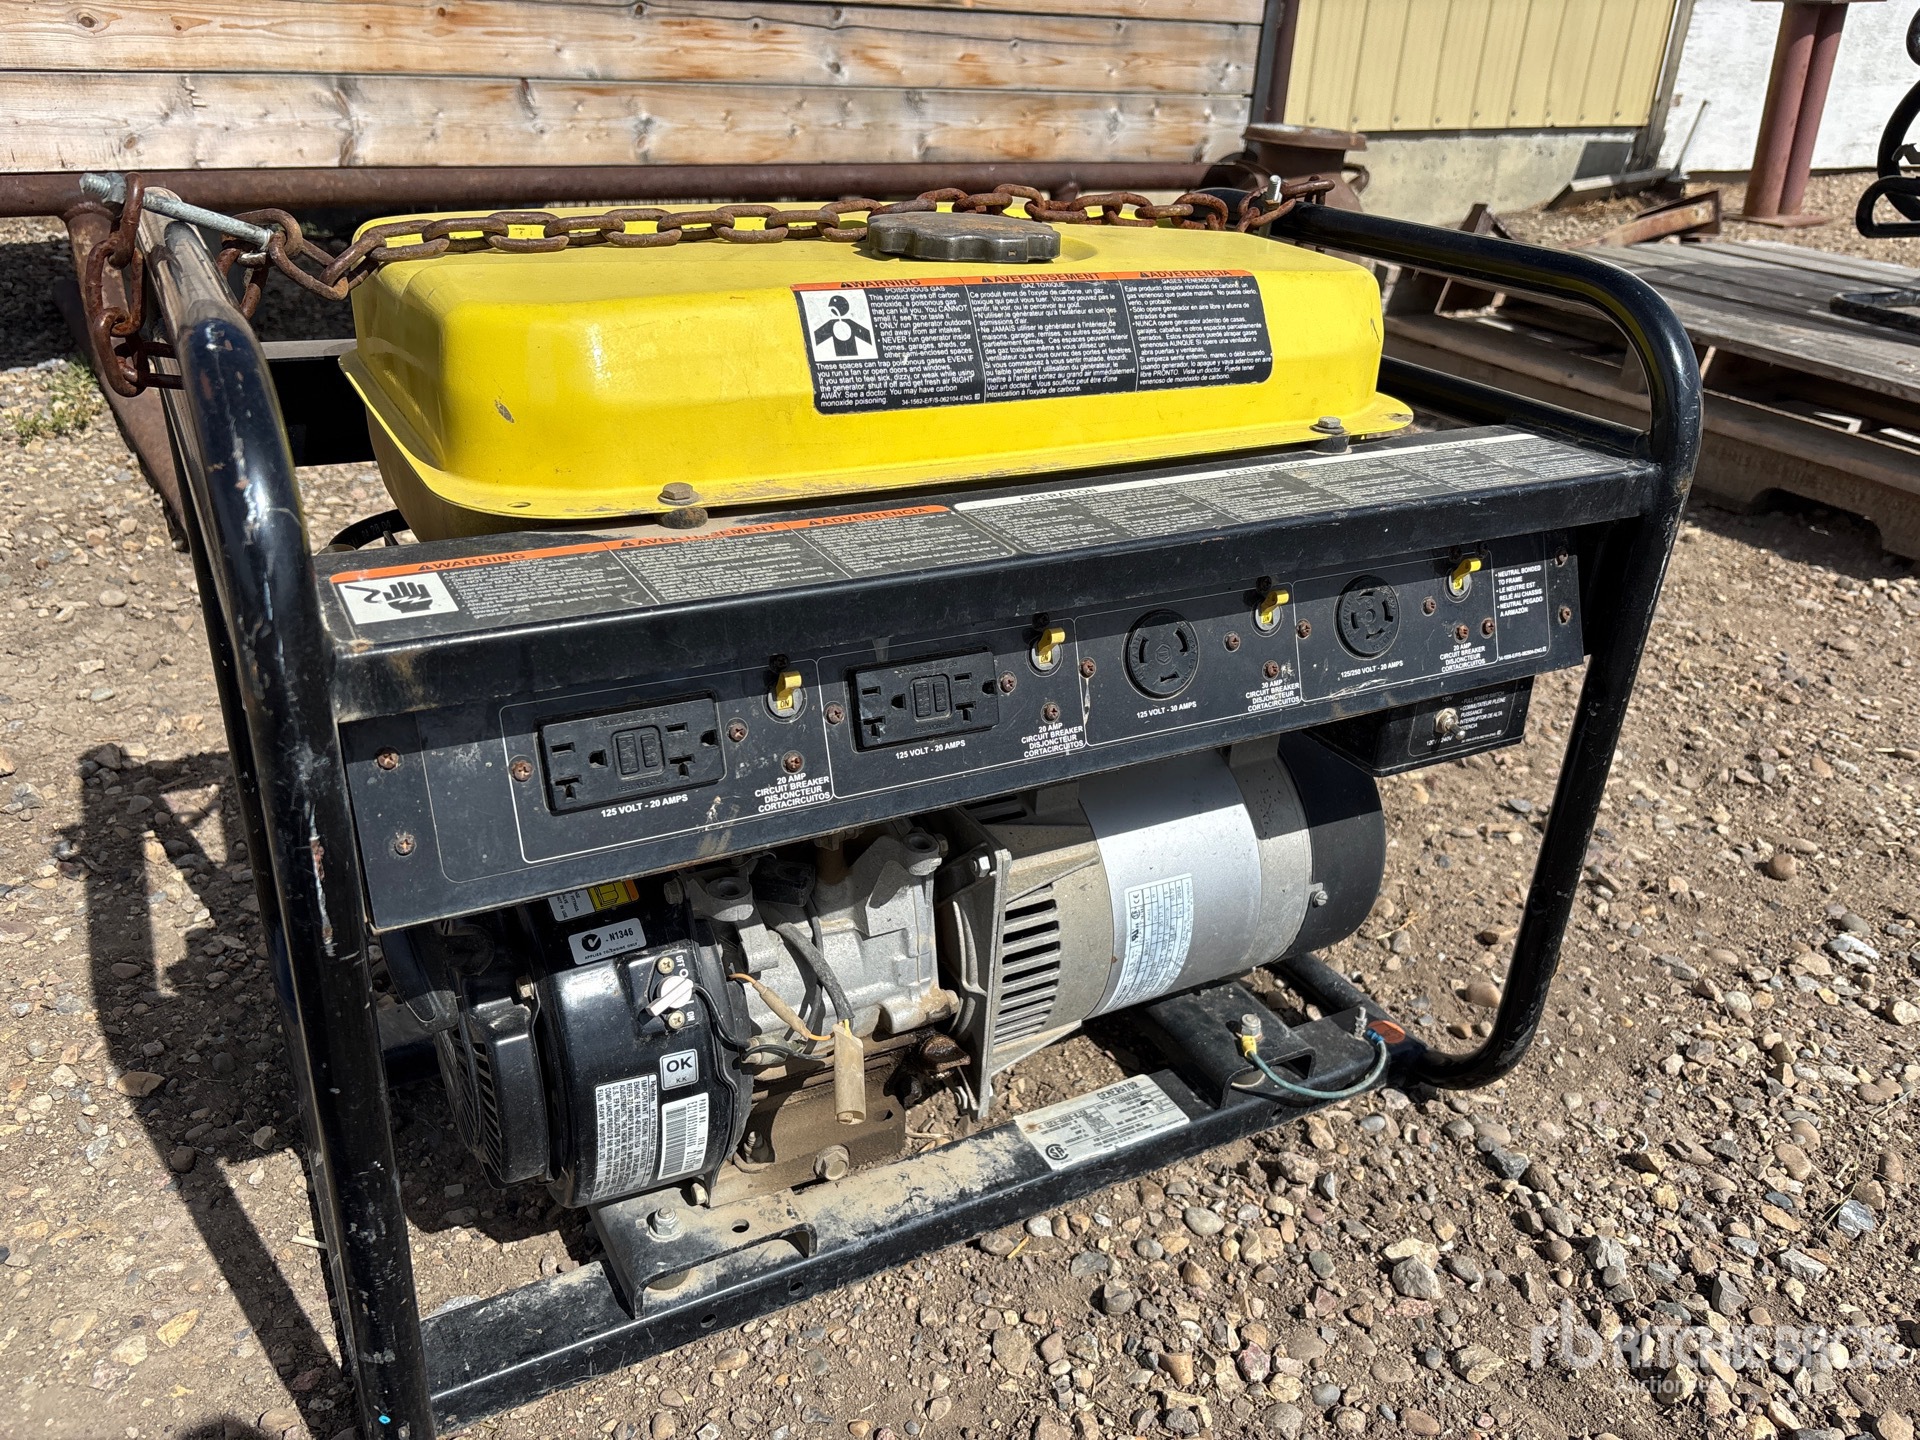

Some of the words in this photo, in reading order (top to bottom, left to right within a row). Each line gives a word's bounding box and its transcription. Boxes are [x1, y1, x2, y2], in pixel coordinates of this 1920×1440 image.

[994, 272, 1100, 283] AVERTISSEMENT
[1150, 269, 1232, 278] ADVERTENCIA
[850, 278, 921, 288] WARNING
[884, 293, 910, 301] product
[938, 304, 968, 312] CANNOT
[879, 321, 898, 329] ONLY
[912, 320, 942, 329] generator
[881, 336, 908, 344] NEVER
[920, 334, 951, 343] generator
[894, 330, 911, 338] away
[1020, 488, 1099, 502] OPERATION
[821, 507, 929, 525] ADVERTENCIA
[433, 554, 526, 569] WARNING
[1497, 568, 1521, 578] NEUTRAL
[1521, 564, 1542, 574] BONDED
[1498, 578, 1505, 586] TO
[1506, 575, 1523, 584] FRAME
[1506, 583, 1525, 592] NEUTRE
[1526, 581, 1536, 589] EST
[1521, 588, 1542, 598] CHASSIS
[1499, 600, 1523, 609] NEUTRAL
[1522, 596, 1543, 605] PEGADO
[1439, 650, 1461, 661] CIRCUIT
[1461, 645, 1486, 656] BREAKER
[1460, 642, 1472, 650] AMP
[1441, 658, 1486, 673] CORTACIRCUITOS
[1445, 652, 1481, 666] DISJONCTEUR
[1340, 668, 1361, 678] 125/250
[1361, 665, 1377, 674] VOLT
[1380, 663, 1387, 671] 20
[1387, 660, 1404, 669] AMPS
[1245, 688, 1269, 699] CIRCUIT
[1270, 682, 1300, 693] BREAKER
[1261, 681, 1269, 689] 30
[1269, 679, 1283, 687] AMP
[780, 700, 790, 708] ON
[1247, 696, 1300, 712] CORTACIRCUITOS
[1252, 690, 1294, 705] DISJONCTEUR
[1136, 710, 1148, 719] 125
[1148, 707, 1165, 717] VOLT
[1170, 704, 1178, 712] 30
[1178, 701, 1197, 711] AMPS
[1021, 732, 1049, 744] CIRCUIT
[1050, 725, 1083, 738] BREAKER
[1038, 725, 1047, 733] 20
[1048, 722, 1063, 731] AMP
[1024, 740, 1084, 758] CORTACIRCUITOS
[1029, 734, 1077, 750] DISJONCTEUR
[895, 750, 909, 760] 125
[909, 746, 929, 757] VOLT
[934, 744, 943, 752] 20
[944, 739, 966, 750] AMPS
[777, 776, 786, 785] 20
[788, 772, 806, 783] AMP
[754, 784, 788, 798] CIRCUIT
[790, 776, 830, 790] BREAKER
[764, 785, 822, 803] DISJONCTEUR
[601, 807, 617, 818] 125
[618, 802, 643, 814] VOLT
[649, 799, 661, 809] 20
[662, 794, 688, 806] AMPS
[758, 791, 831, 813] CORTACIRCUITOS
[608, 927, 634, 941] N1346
[675, 954, 686, 967] OFF
[686, 1010, 696, 1021] ON
[666, 1056, 693, 1073] OK
[1096, 1081, 1140, 1100] GENERATOR
